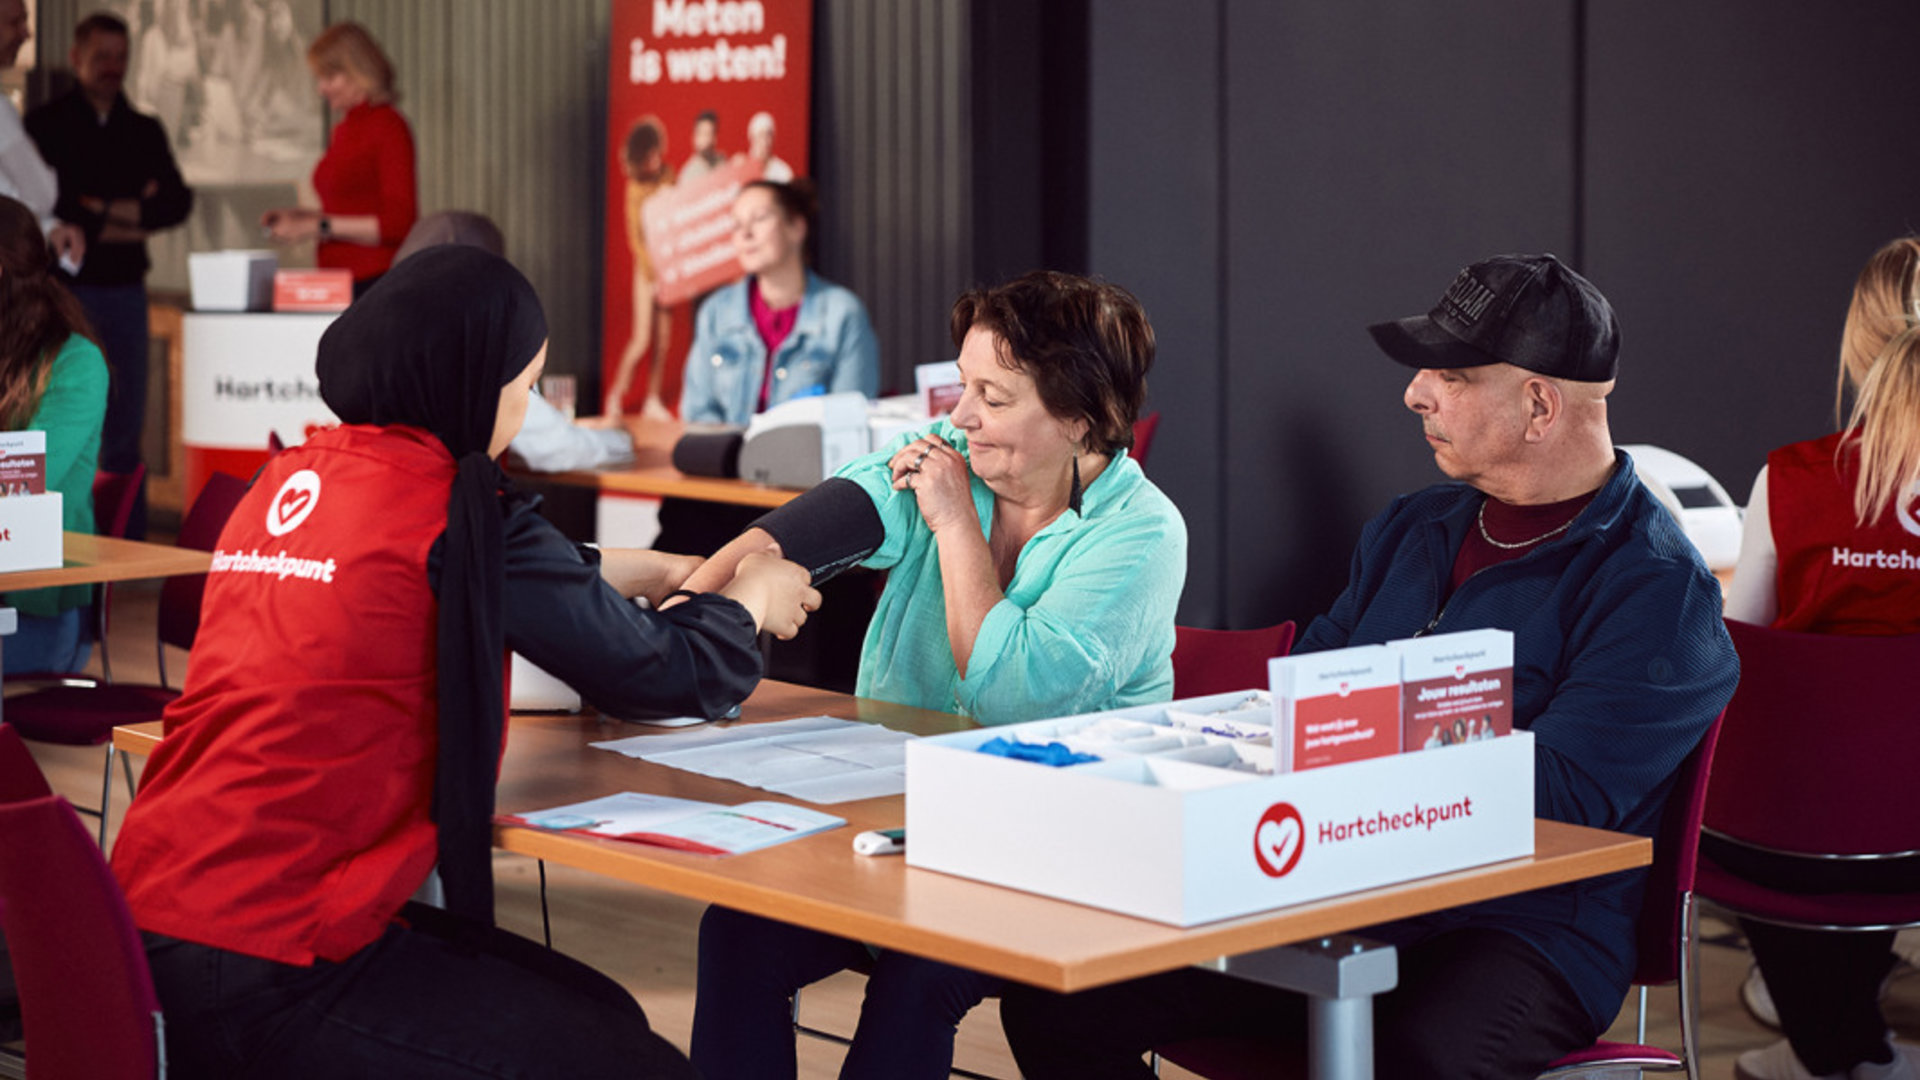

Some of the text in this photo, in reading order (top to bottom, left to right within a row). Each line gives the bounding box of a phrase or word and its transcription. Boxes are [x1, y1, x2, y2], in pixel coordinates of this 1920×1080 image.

[653, 0, 764, 37] Meten
[630, 33, 787, 84] is weten!
[1832, 546, 1920, 570] Hartch
[1417, 687, 1447, 702] Jouw
[1448, 678, 1502, 697] resultaten
[1318, 797, 1473, 844] Hartcheckpunt
